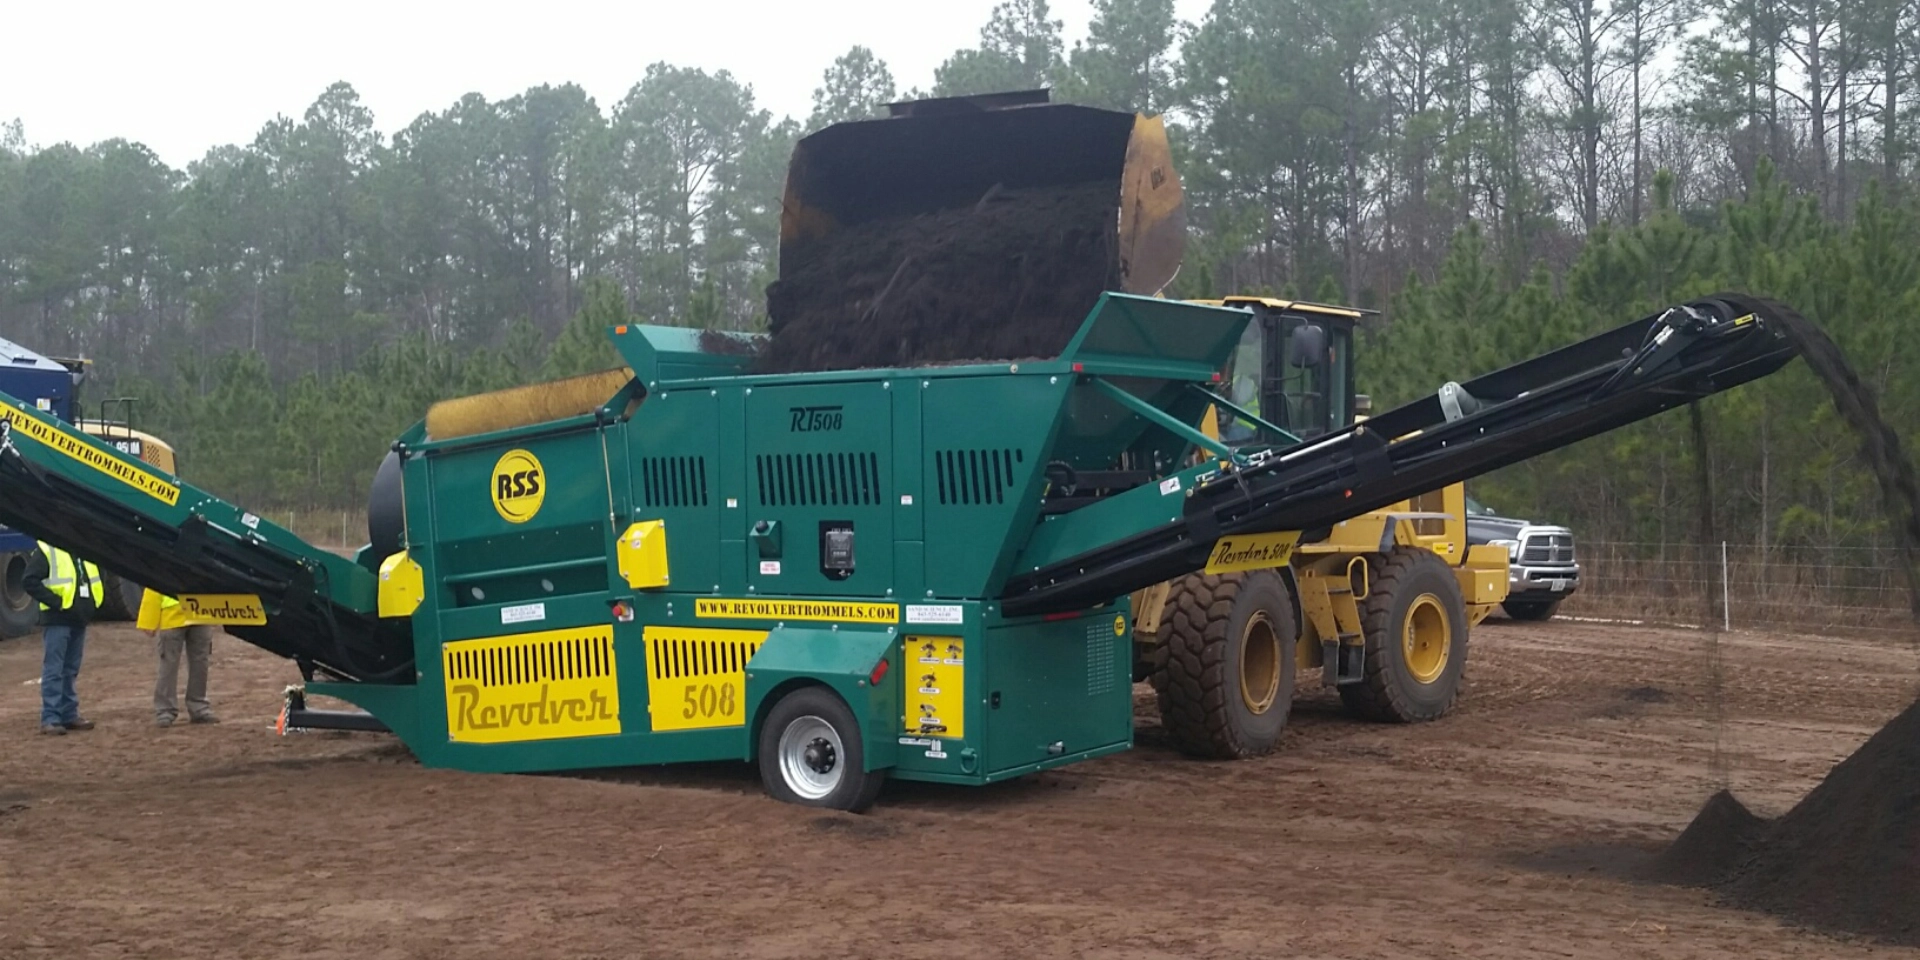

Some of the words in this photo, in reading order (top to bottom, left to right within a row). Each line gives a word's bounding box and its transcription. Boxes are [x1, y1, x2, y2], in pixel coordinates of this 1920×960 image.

[789, 405, 843, 432] RT508
[0, 405, 175, 501] .REVOLVERTROMMELS.COM
[498, 469, 540, 500] RSS
[699, 602, 896, 620] WWW.REVOLVERTROMMELS.COM
[452, 683, 613, 732] Revolver
[682, 682, 735, 720] 508
